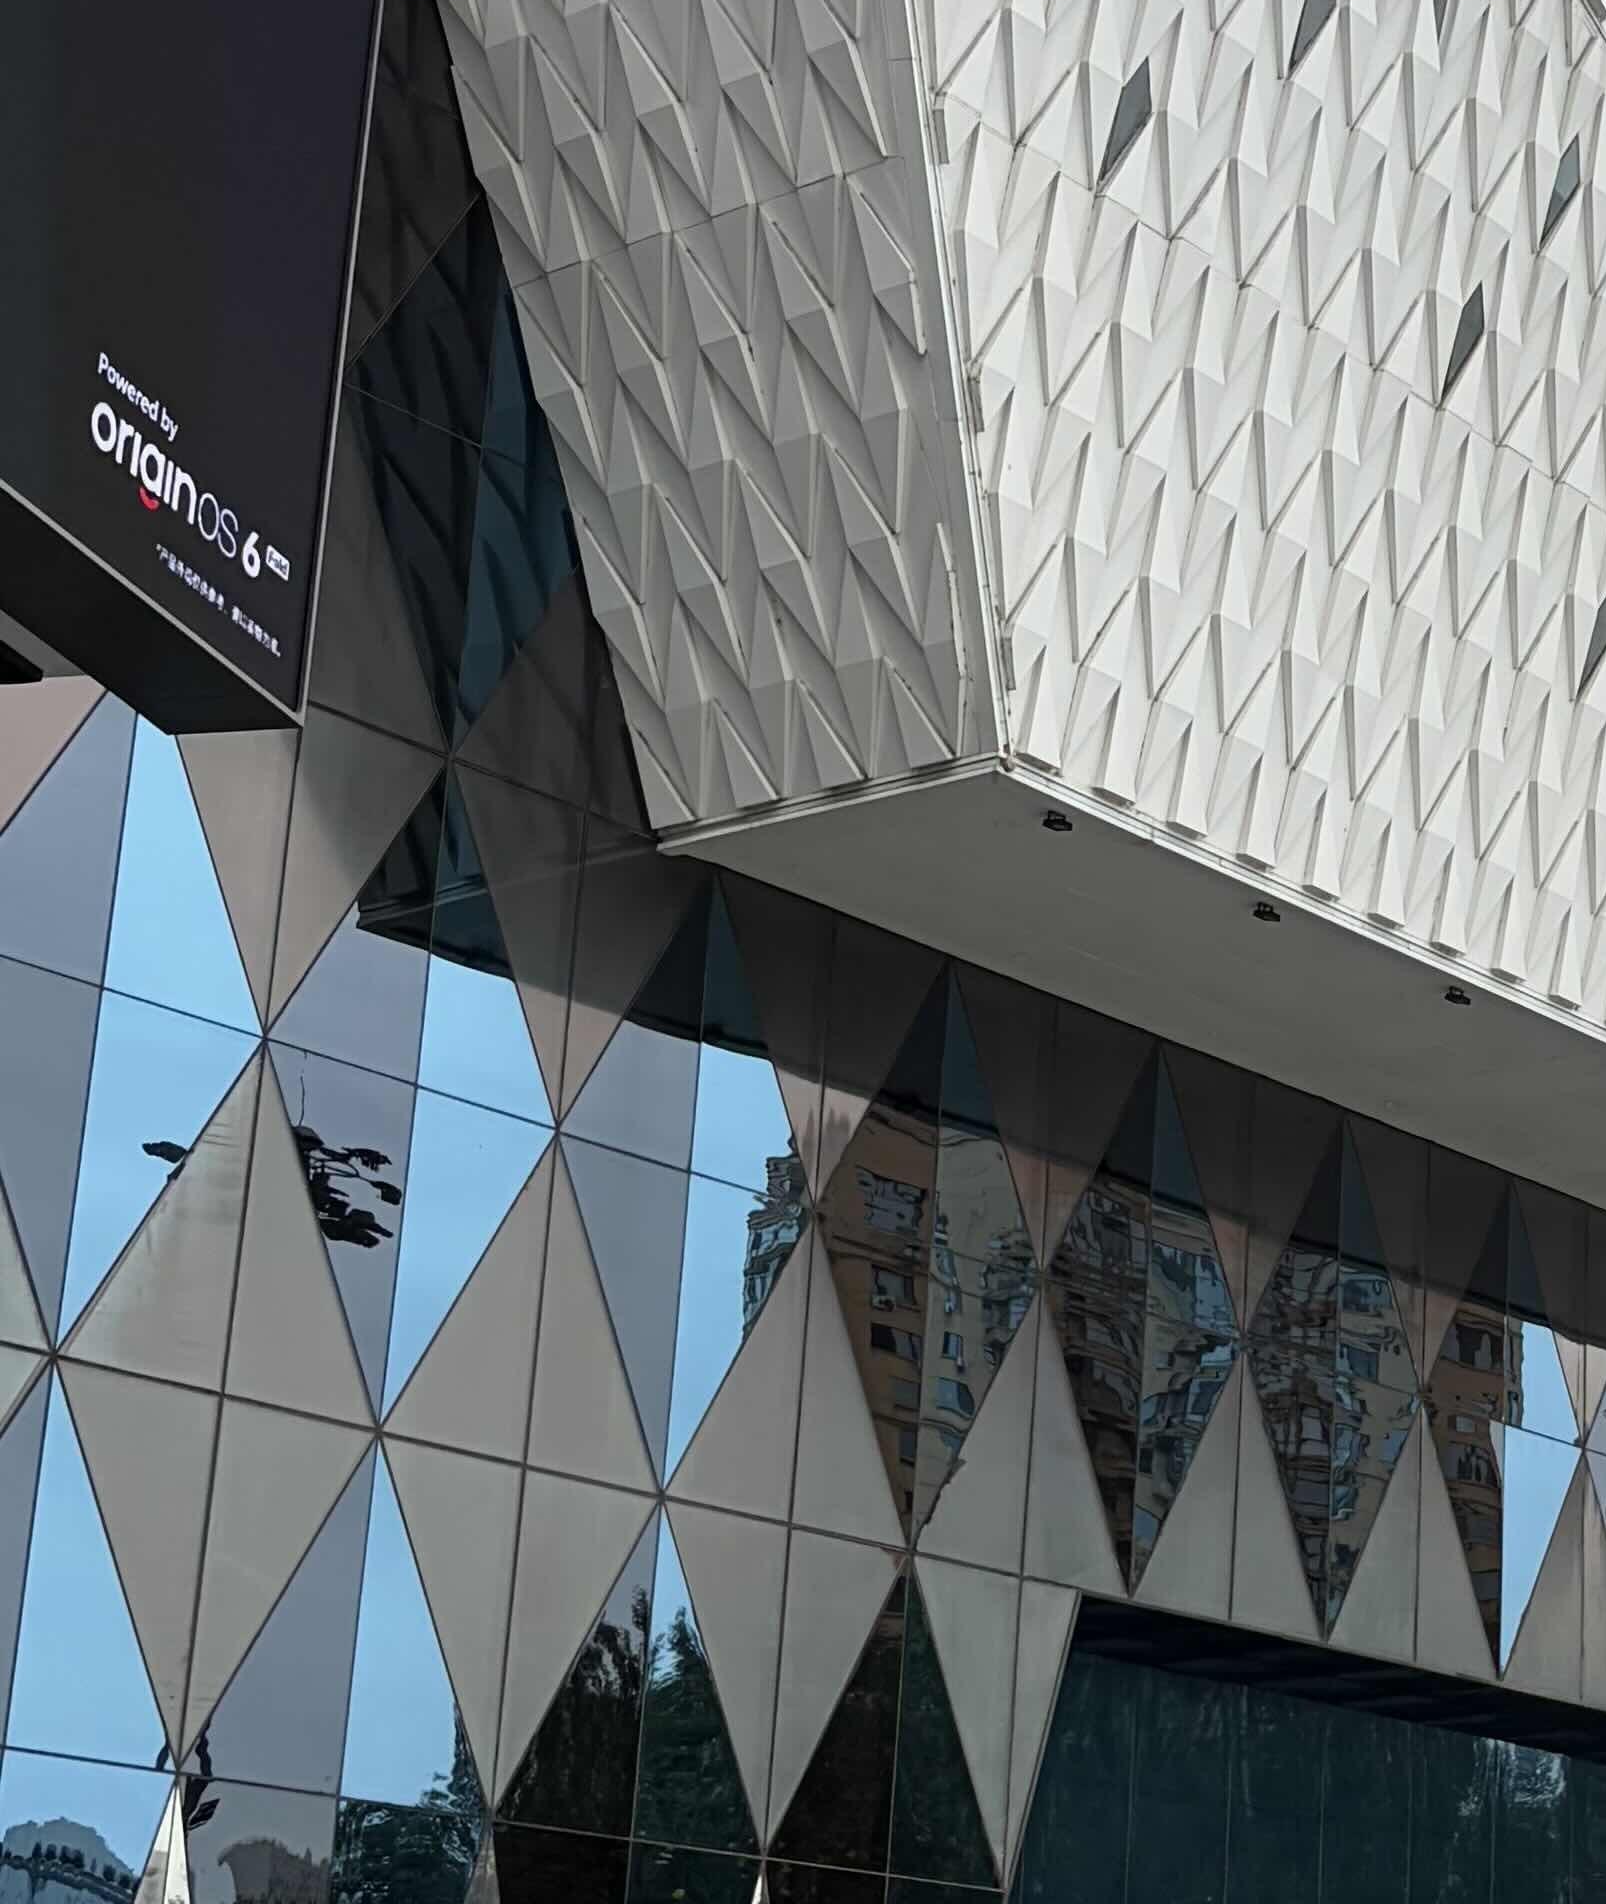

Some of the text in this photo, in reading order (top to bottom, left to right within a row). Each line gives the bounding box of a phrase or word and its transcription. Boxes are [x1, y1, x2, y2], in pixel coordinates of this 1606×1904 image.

[98, 351, 179, 443] Powered by
[242, 531, 261, 579] 6
